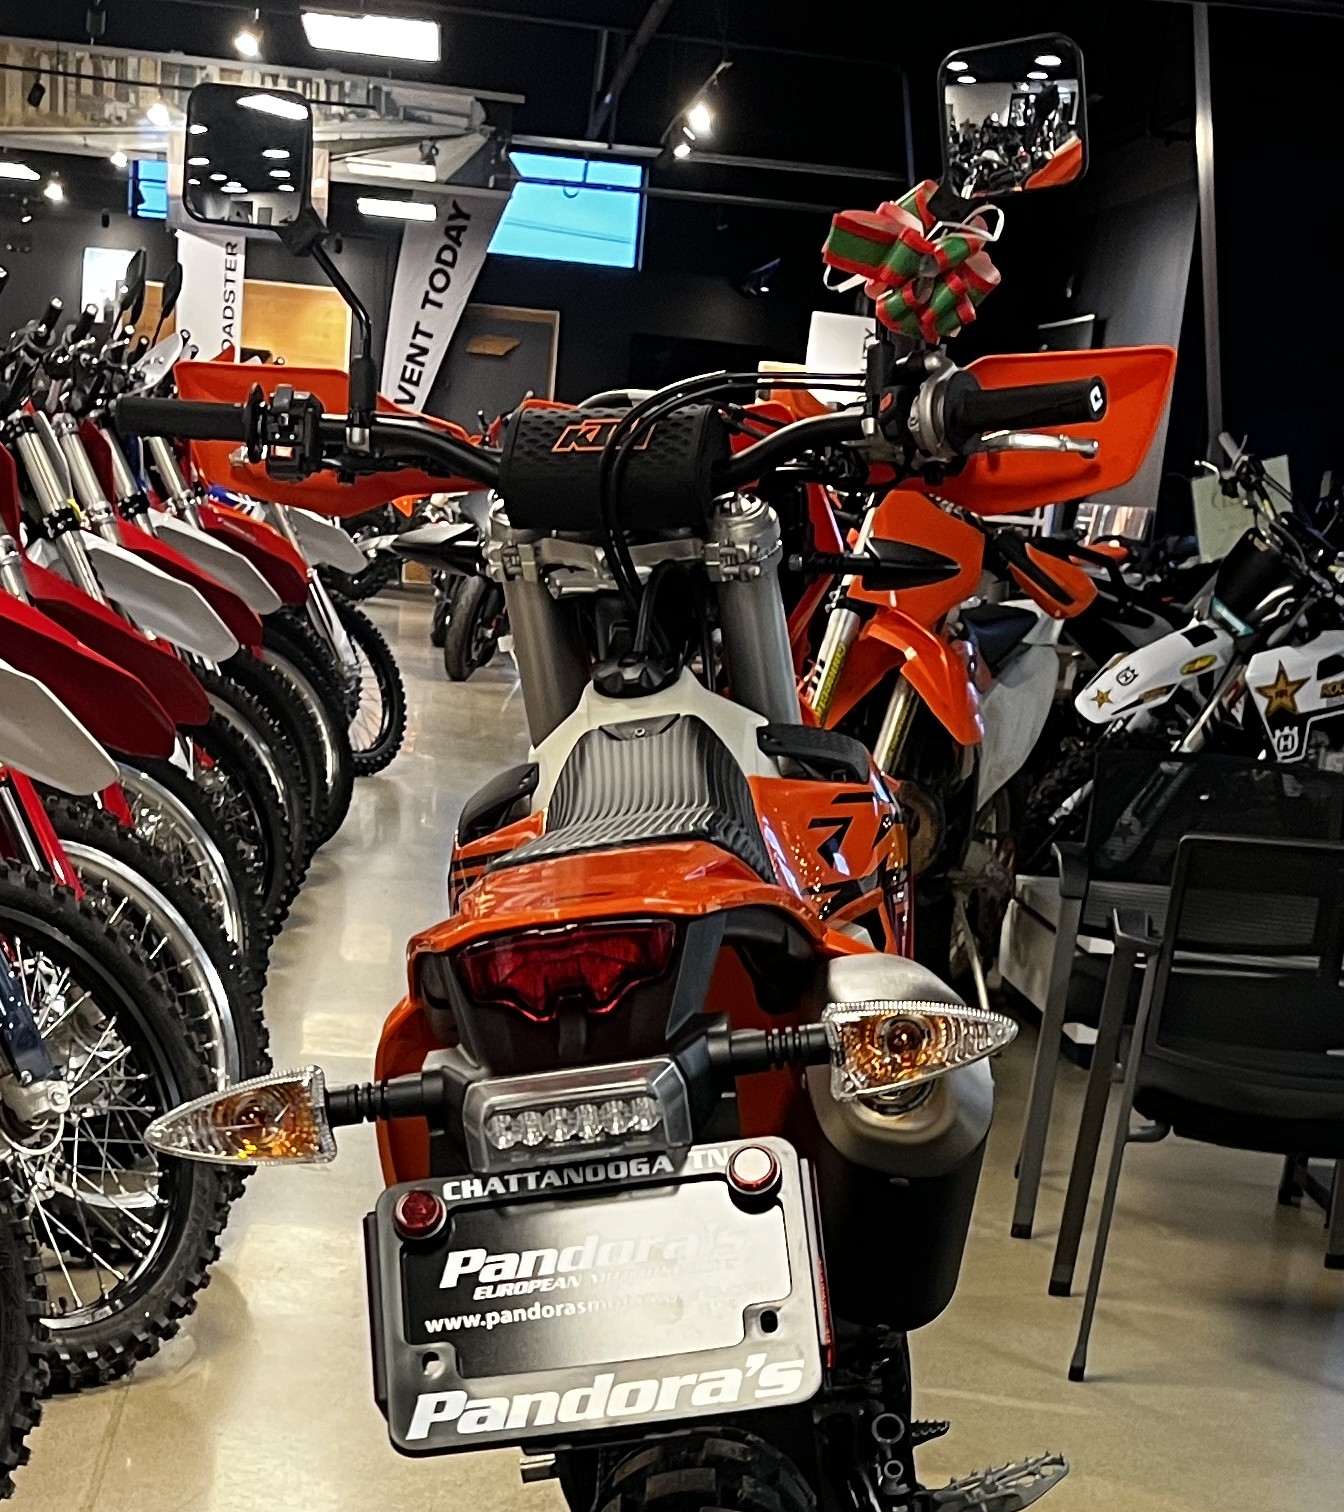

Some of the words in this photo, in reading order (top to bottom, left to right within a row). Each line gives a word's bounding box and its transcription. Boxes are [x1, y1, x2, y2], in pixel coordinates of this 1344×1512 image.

[221, 241, 239, 351] OADSTER
[394, 321, 434, 406] VENT
[420, 199, 472, 310] TODAY
[442, 1156, 675, 1201] CHATTANOOGA
[687, 1147, 730, 1173] TN
[439, 1222, 747, 1290] Pandora's
[472, 1275, 581, 1302] EUROPEAN
[405, 1353, 805, 1441] Pandora's
